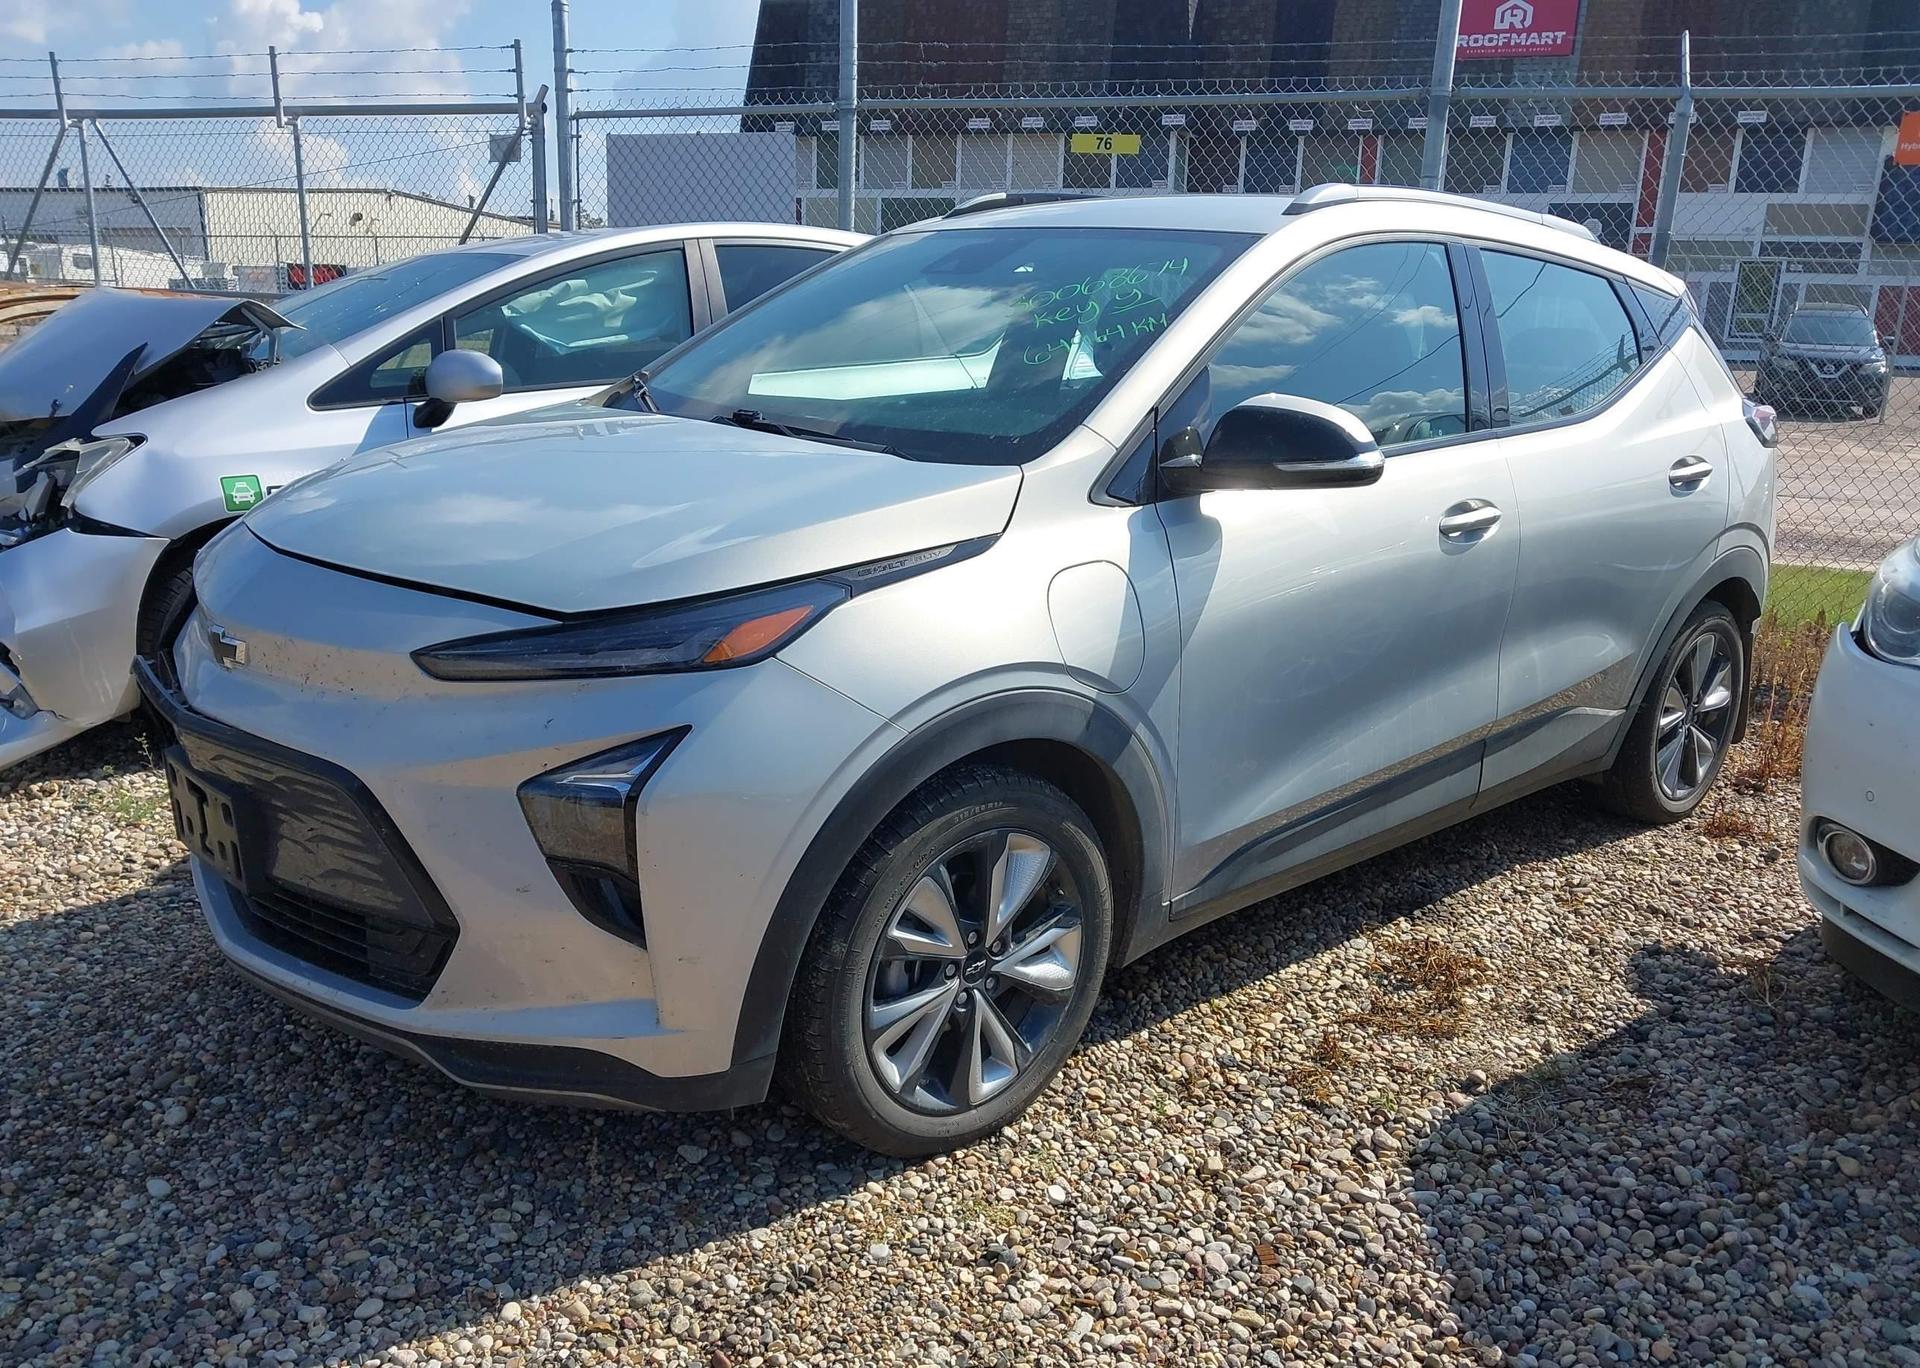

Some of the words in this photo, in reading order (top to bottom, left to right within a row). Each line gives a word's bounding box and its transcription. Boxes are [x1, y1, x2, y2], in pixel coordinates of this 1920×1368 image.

[1457, 31, 1567, 48] ROOFMART
[1096, 137, 1113, 150] 76
[1900, 142, 1920, 151] Hyb
